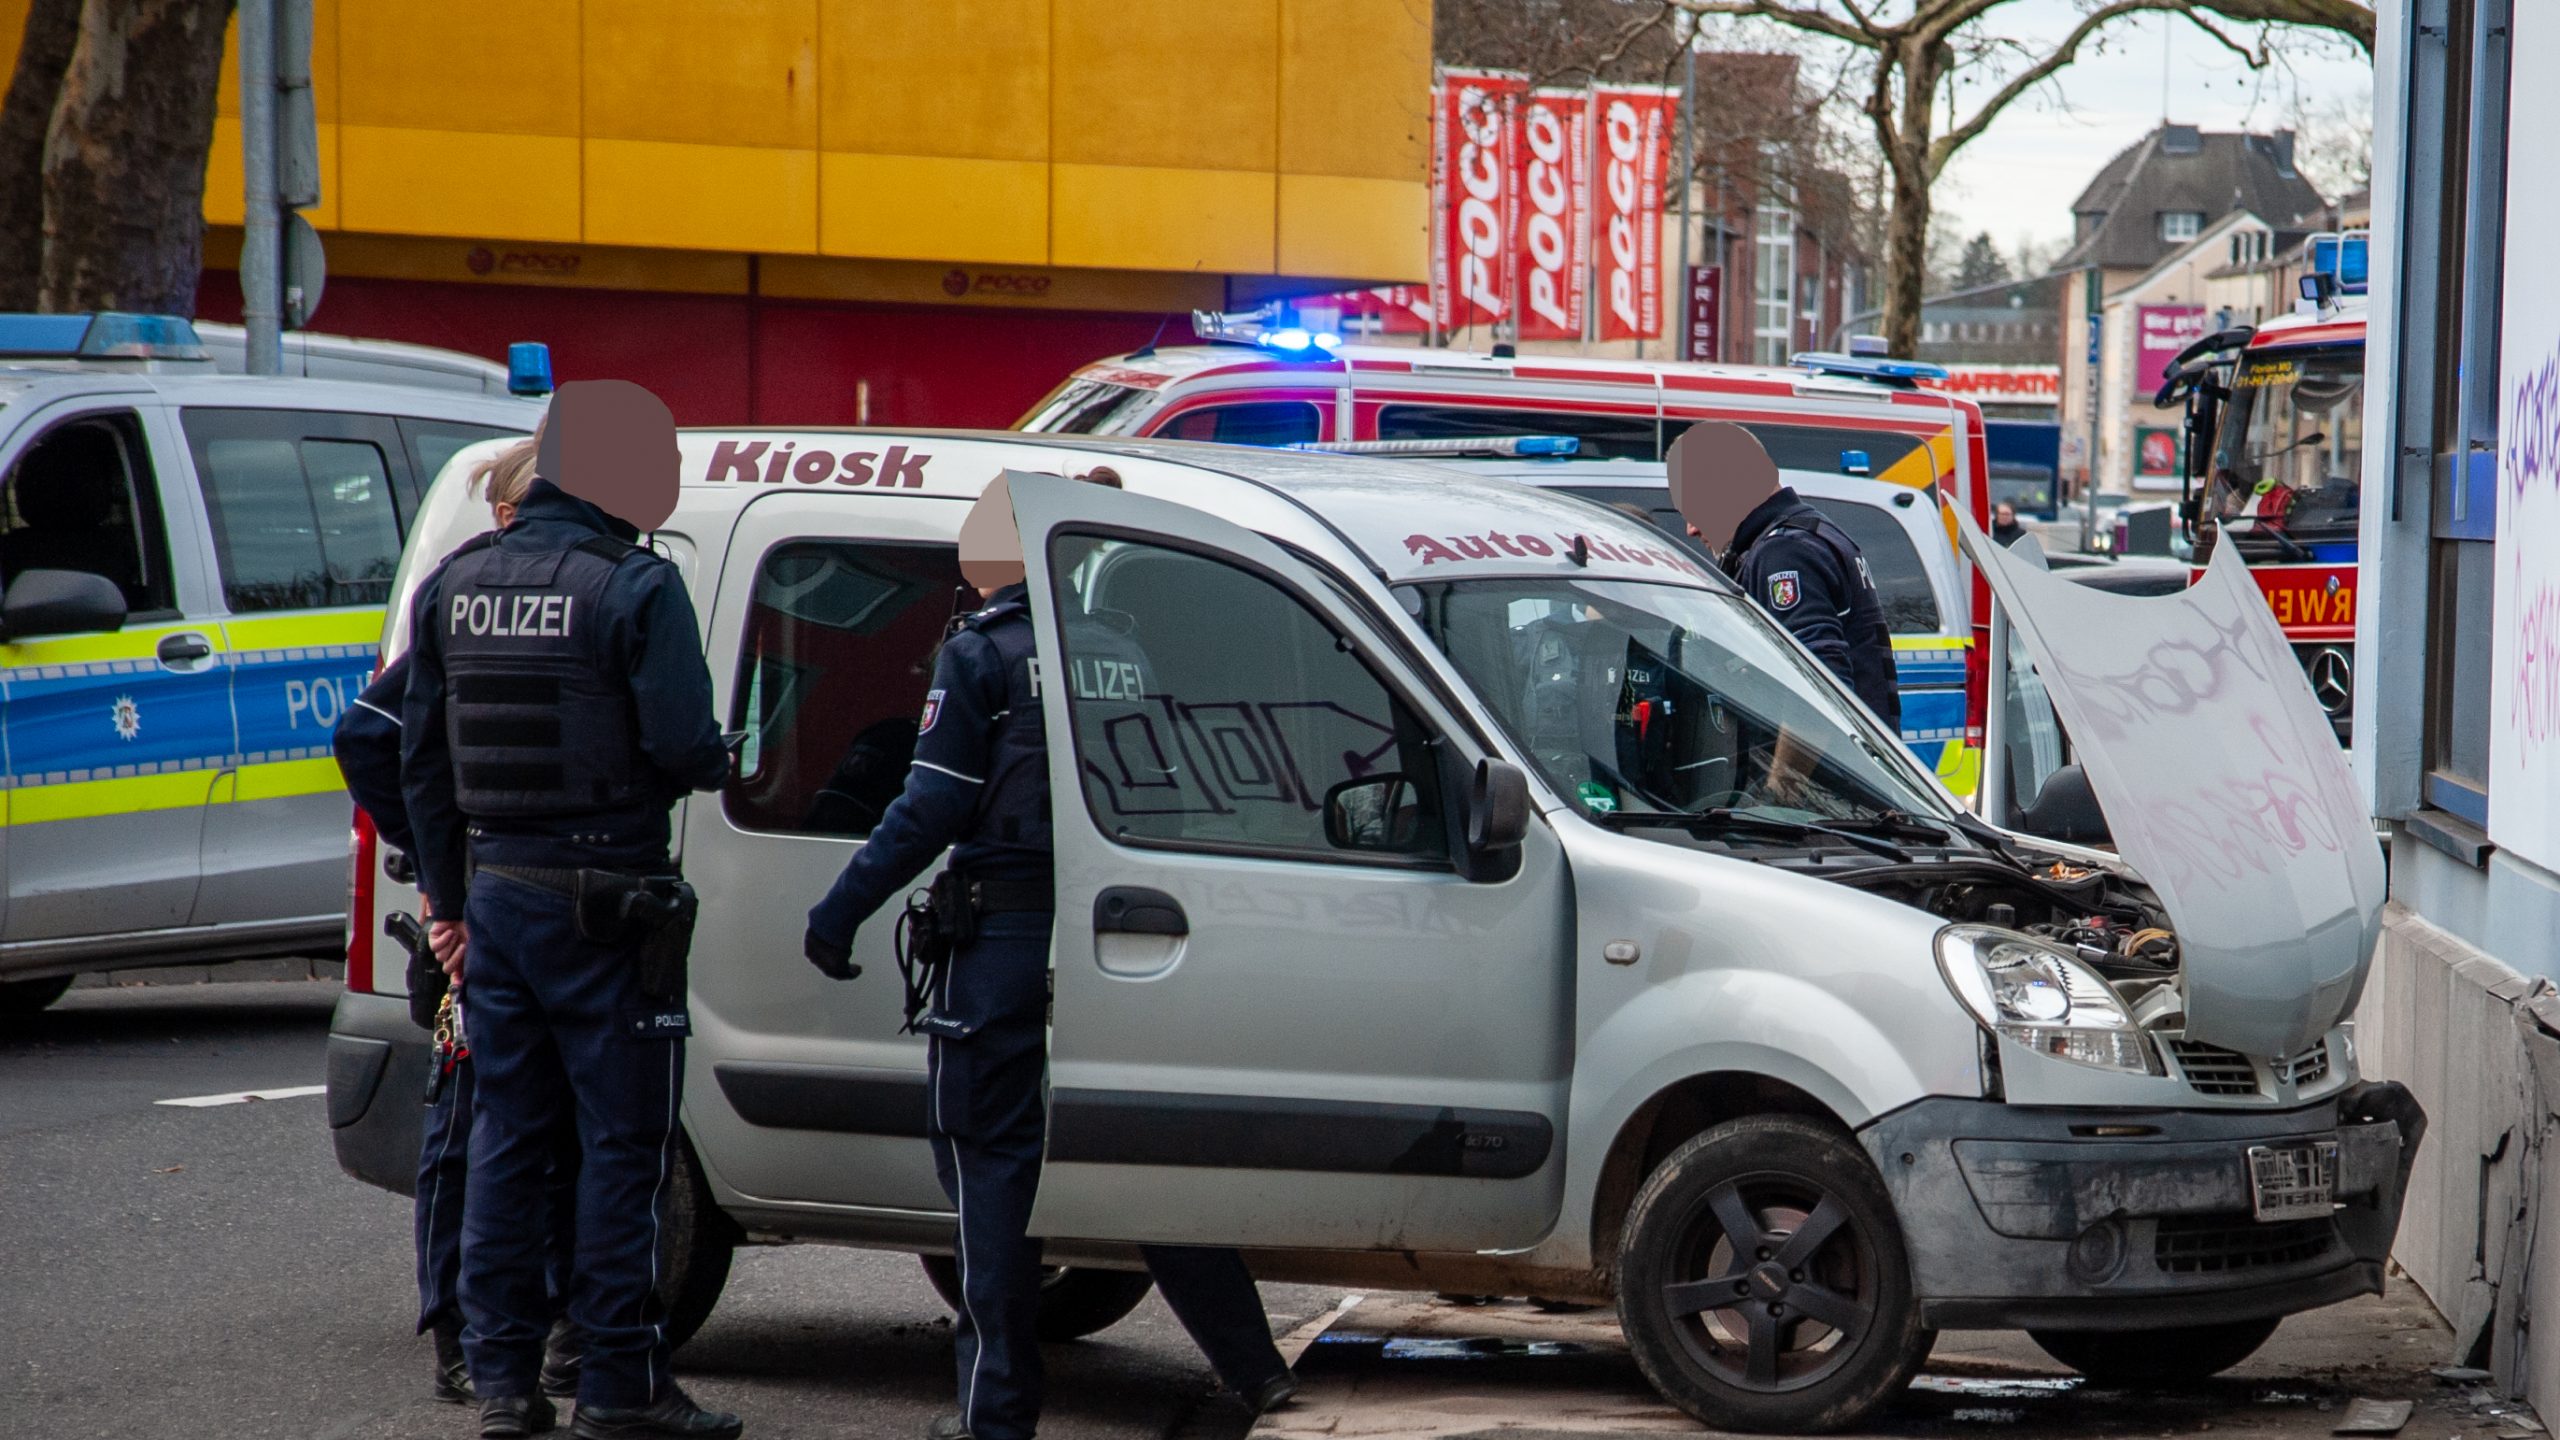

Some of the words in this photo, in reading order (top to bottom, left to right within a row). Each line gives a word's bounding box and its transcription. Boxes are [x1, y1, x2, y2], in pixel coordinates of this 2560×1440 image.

[1459, 85, 1501, 317] POCO
[1526, 103, 1569, 330] POCO
[1606, 100, 1639, 333] POCO
[1693, 267, 1714, 361] FRISE
[705, 440, 934, 489] Kiosk
[1403, 529, 1555, 566] Auto
[450, 594, 573, 637] POLIZEI
[1026, 656, 1145, 702] PLIZEI
[1627, 669, 1650, 683] IZEI
